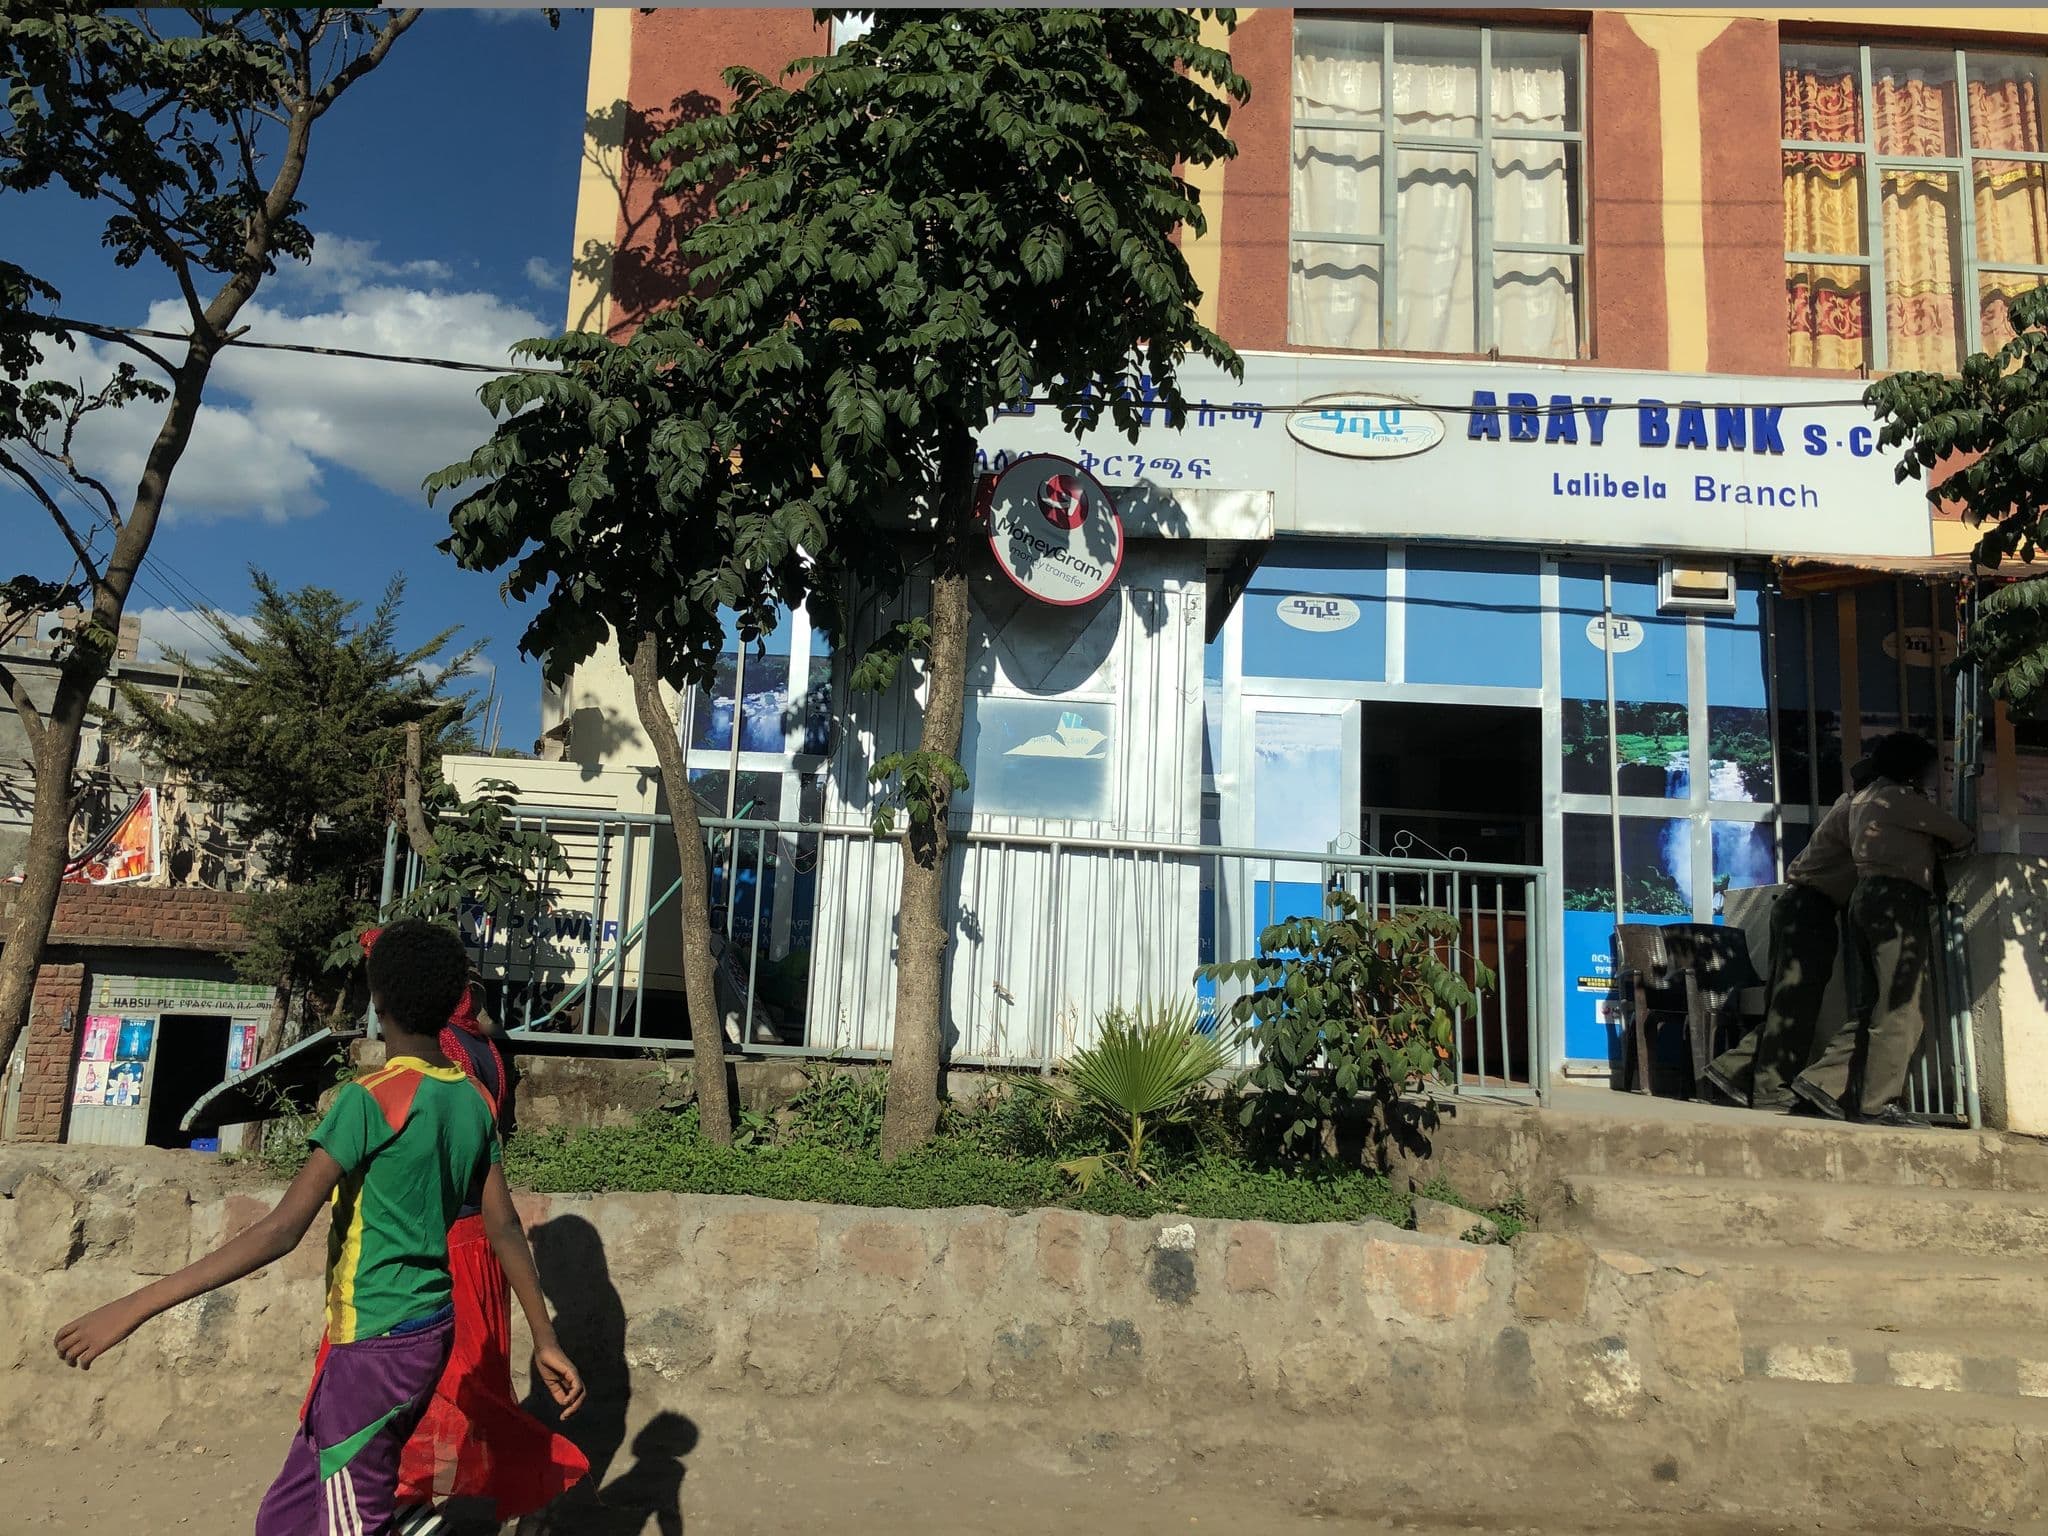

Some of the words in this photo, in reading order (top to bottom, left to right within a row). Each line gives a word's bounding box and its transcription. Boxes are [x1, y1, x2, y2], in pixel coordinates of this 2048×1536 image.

[1468, 390, 1612, 446] ABAY
[1638, 398, 1785, 456] BANK
[1552, 472, 1667, 499] Lalibela
[1694, 474, 1819, 508] Branch
[997, 516, 1103, 581] MoneyGram
[1010, 546, 1044, 569] money
[1044, 561, 1086, 588] transfer
[113, 997, 150, 1009] HABSU
[157, 999, 174, 1009] PLC
